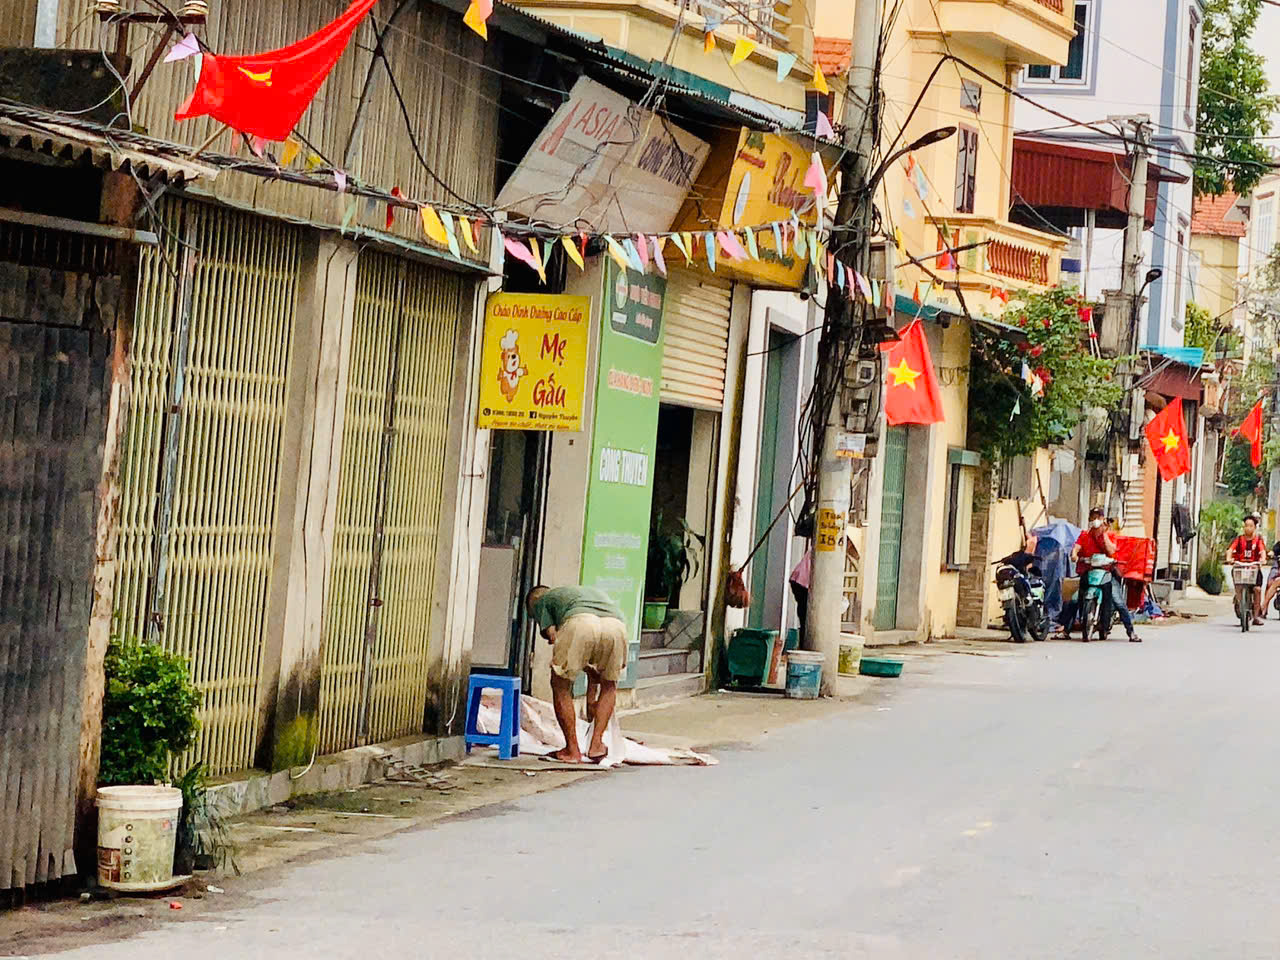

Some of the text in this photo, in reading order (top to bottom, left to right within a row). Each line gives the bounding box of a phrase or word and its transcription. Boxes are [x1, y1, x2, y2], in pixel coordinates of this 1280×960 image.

[573, 101, 621, 142] ASIA
[493, 304, 511, 318] Cháo
[554, 307, 567, 321] Cao
[540, 333, 567, 367] Mẹ
[533, 373, 566, 408] Gấu
